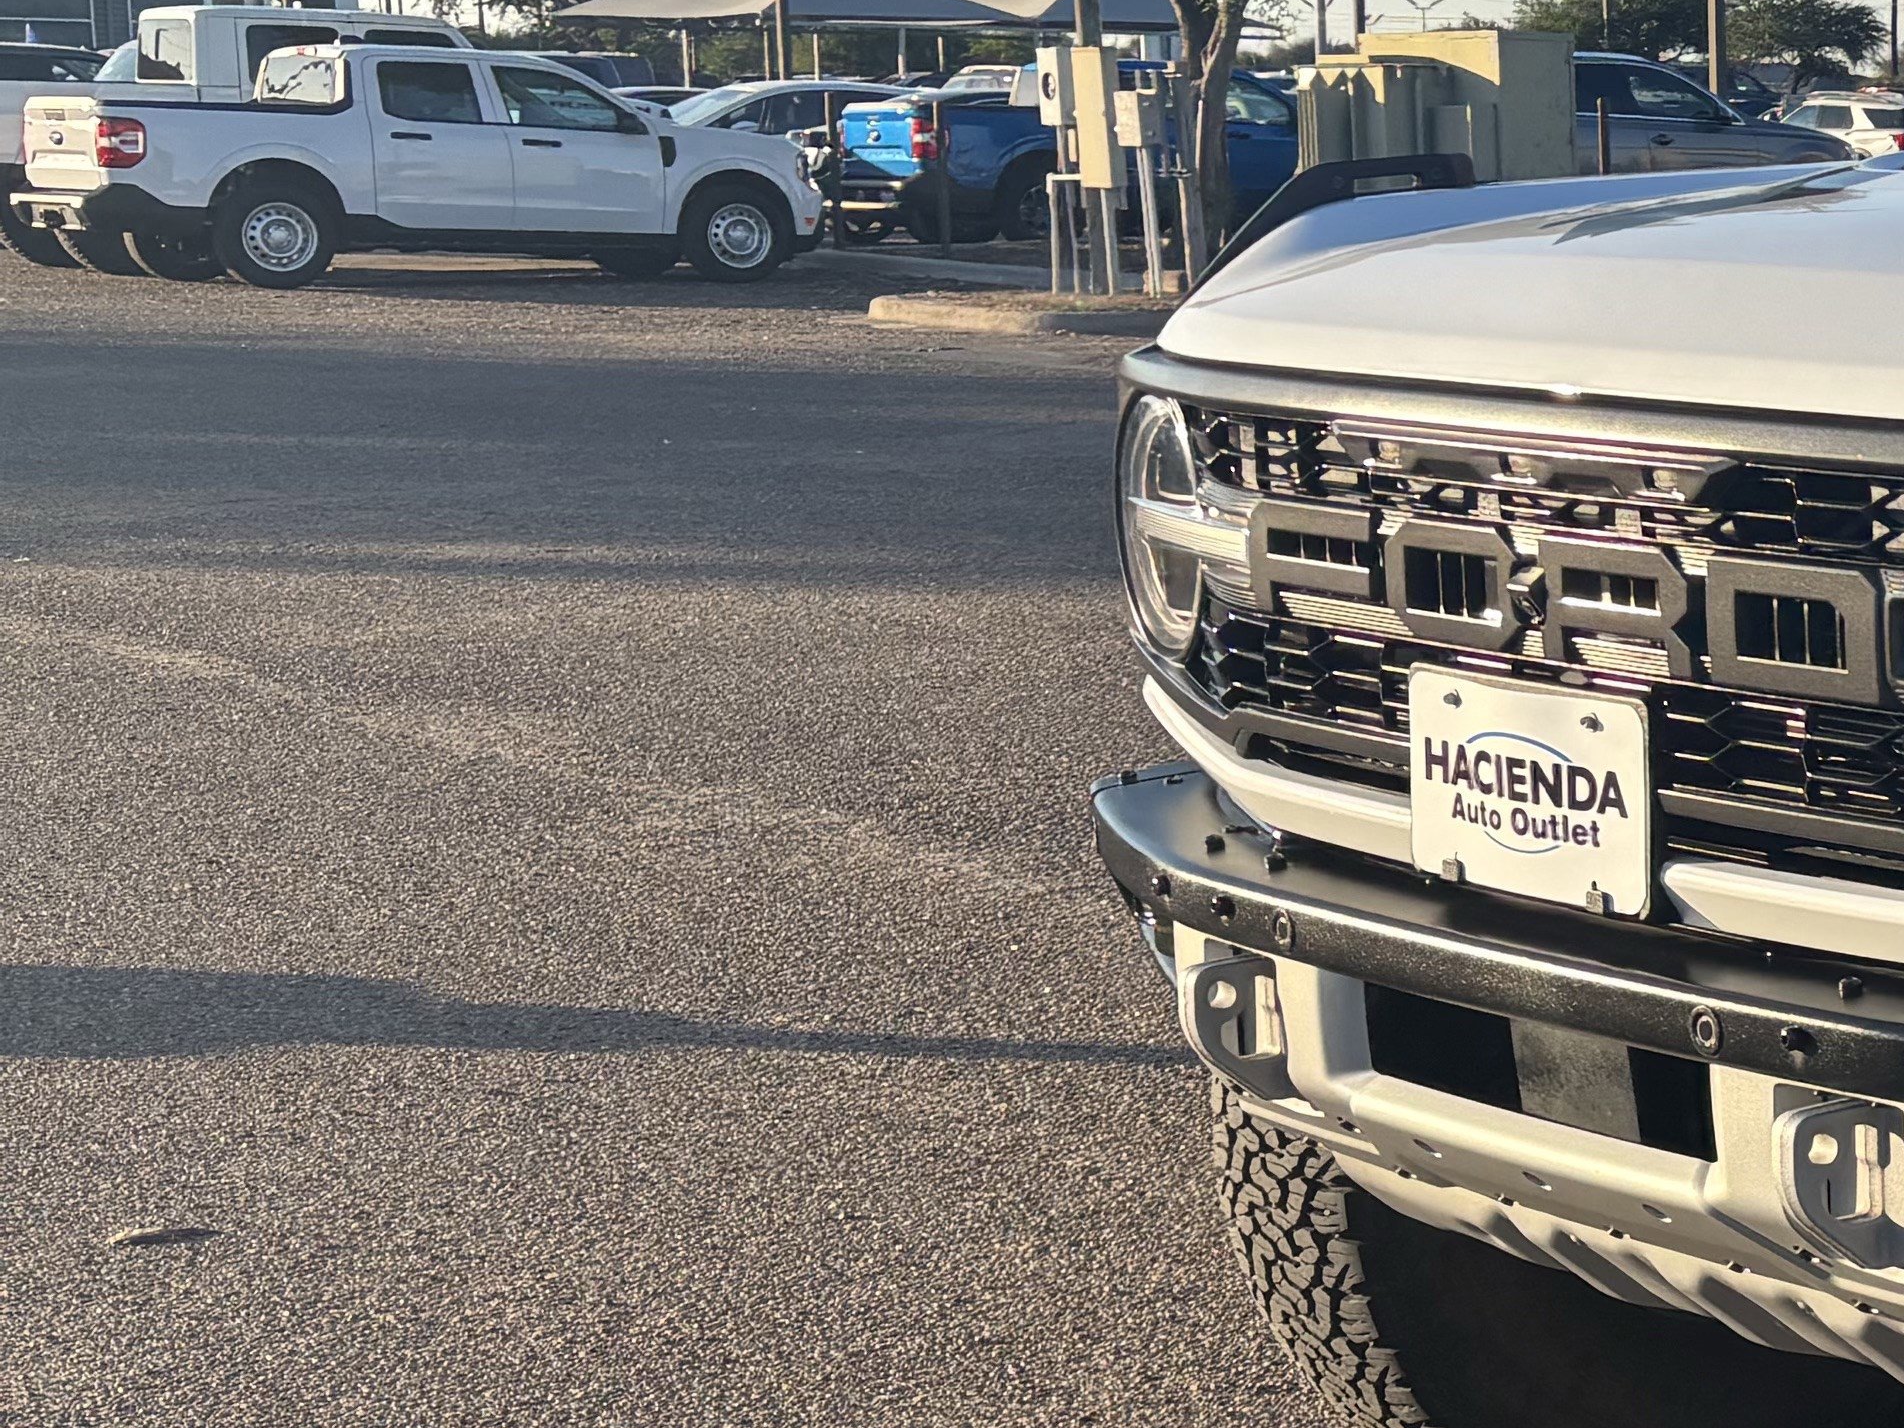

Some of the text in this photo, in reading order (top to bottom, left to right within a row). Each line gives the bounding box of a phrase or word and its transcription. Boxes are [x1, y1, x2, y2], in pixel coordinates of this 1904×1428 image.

[1248, 499, 1882, 707] FORD
[1424, 735, 1629, 819] HACIENDA
[1451, 795, 1601, 849] Auto Outlet
